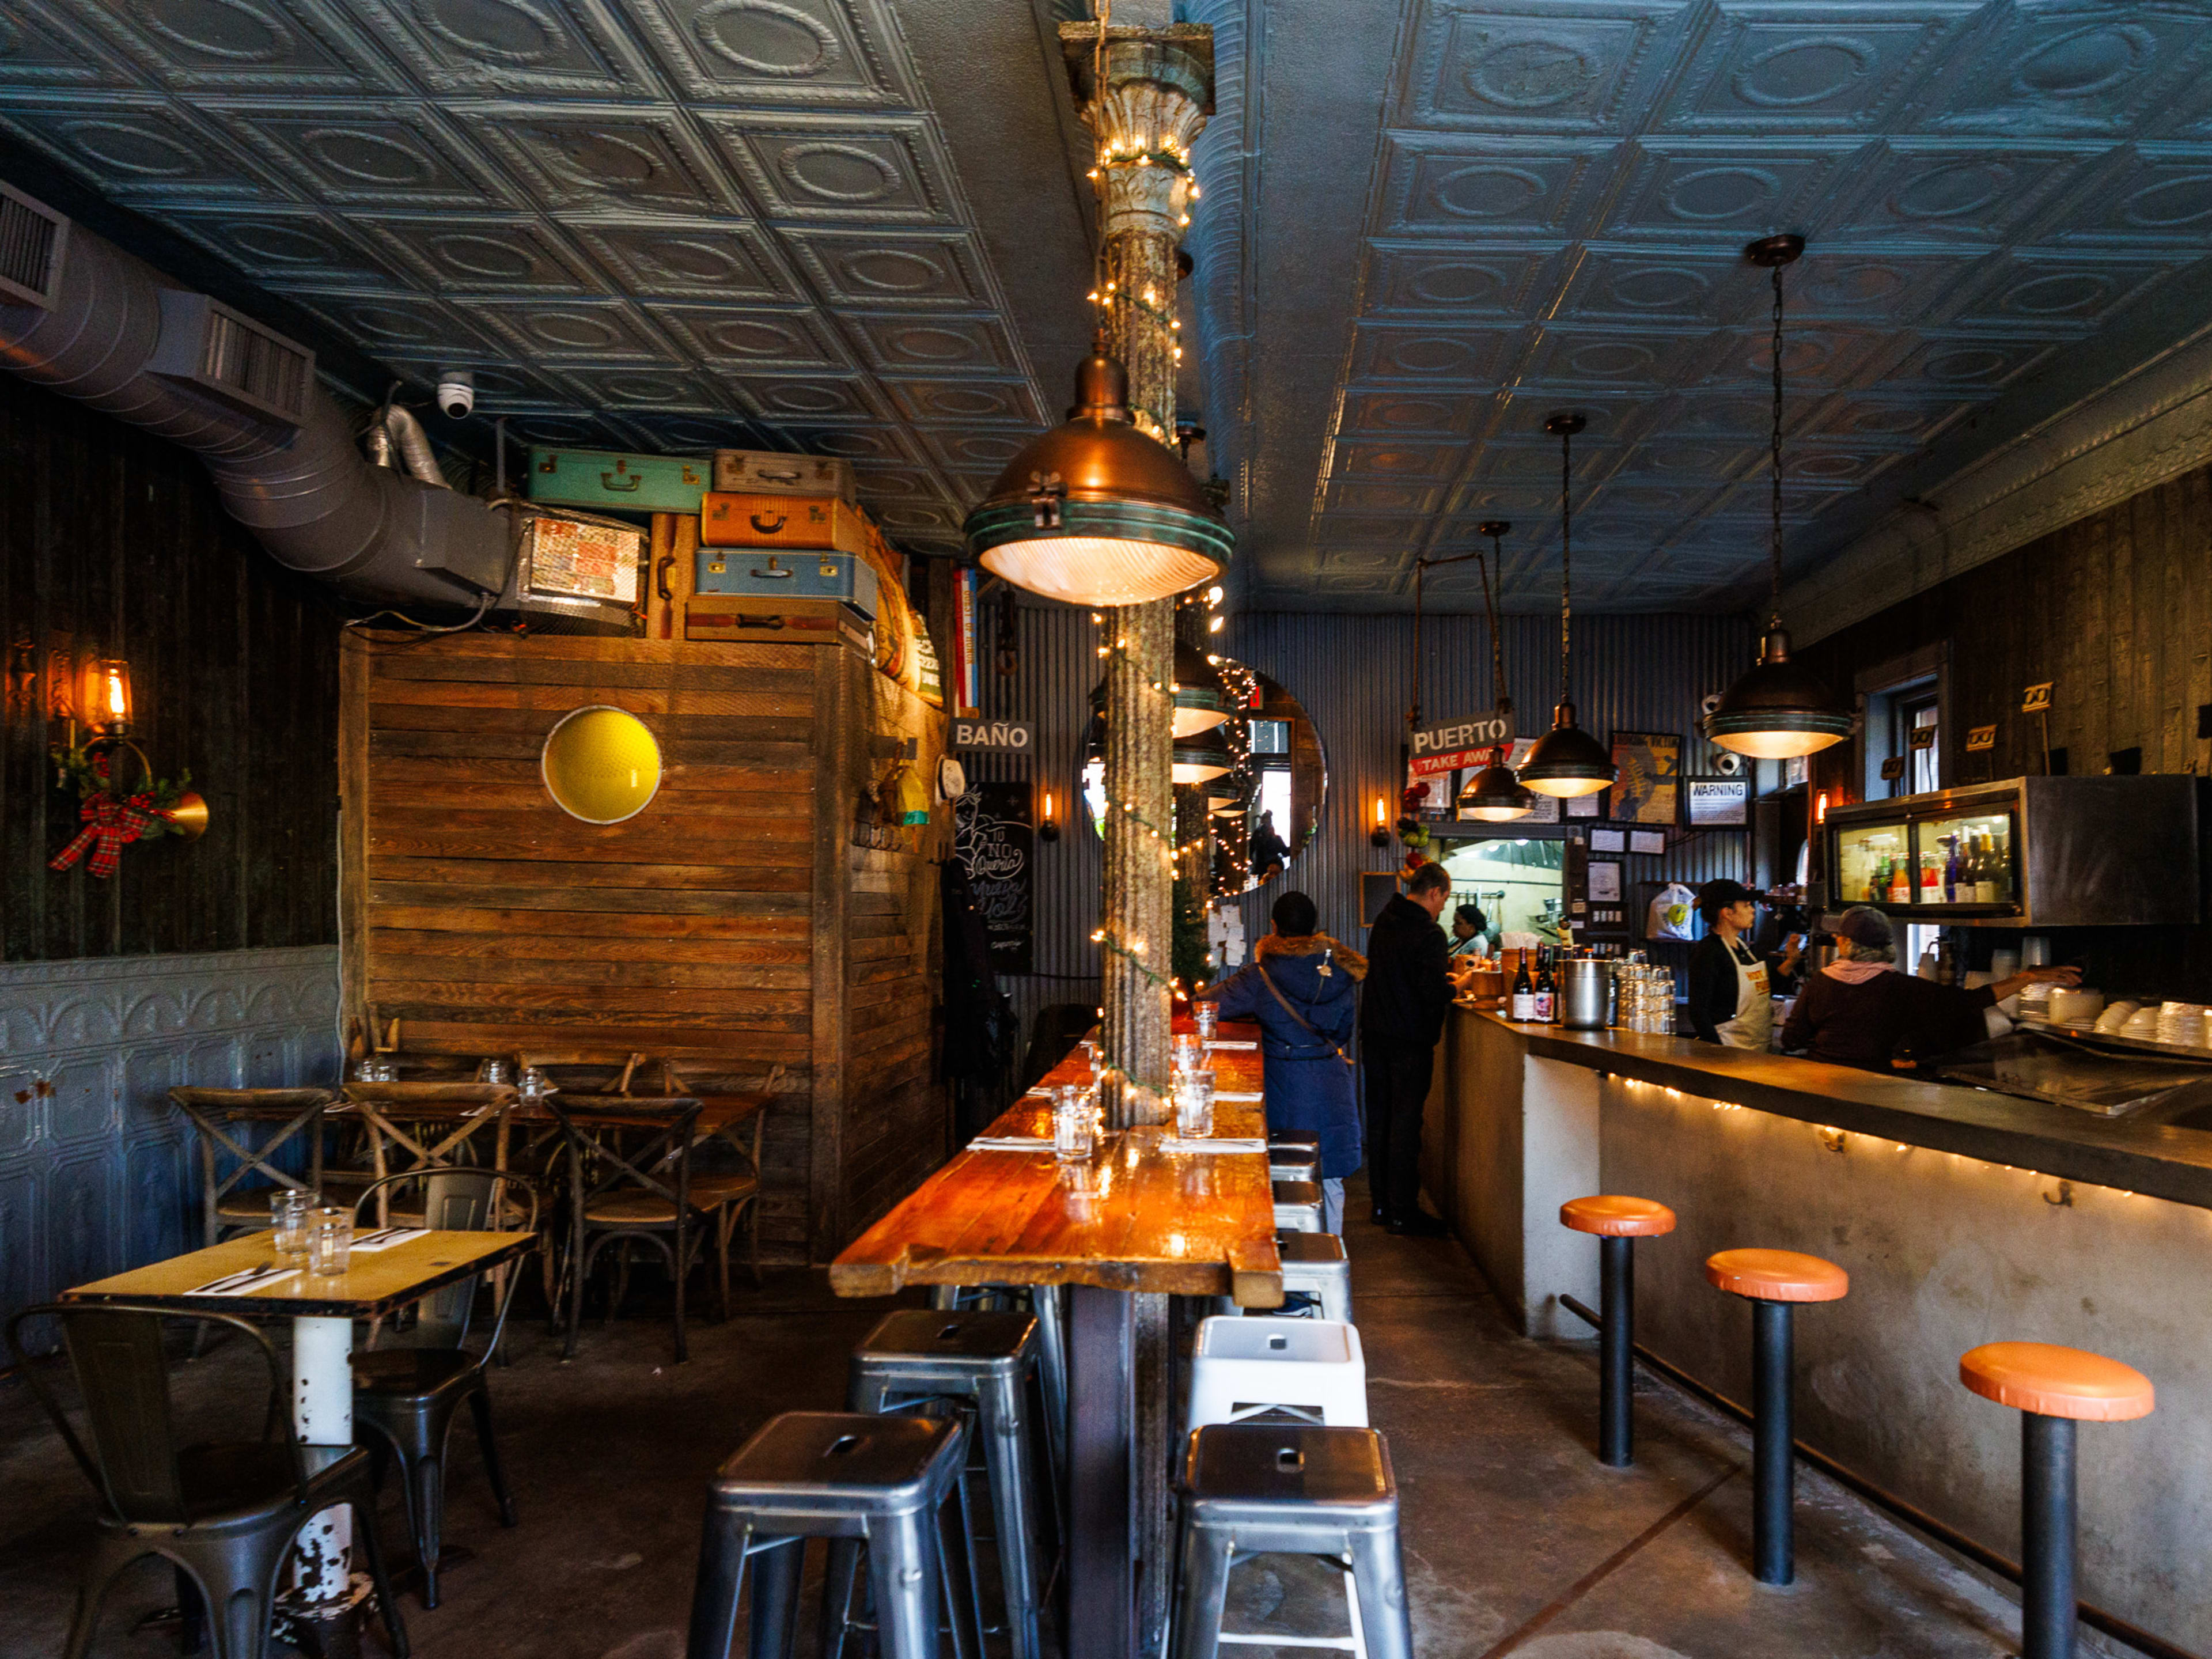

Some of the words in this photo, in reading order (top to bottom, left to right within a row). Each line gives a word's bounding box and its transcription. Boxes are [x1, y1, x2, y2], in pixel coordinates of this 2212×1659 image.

[965, 622, 975, 632] OF
[956, 722, 1028, 748] BAÑO
[1414, 719, 1507, 753] PUERTO
[1422, 755, 1459, 772] TAKE
[1463, 748, 1505, 765] AWA
[1693, 784, 1743, 796] WARNING
[987, 843, 1013, 859] NO
